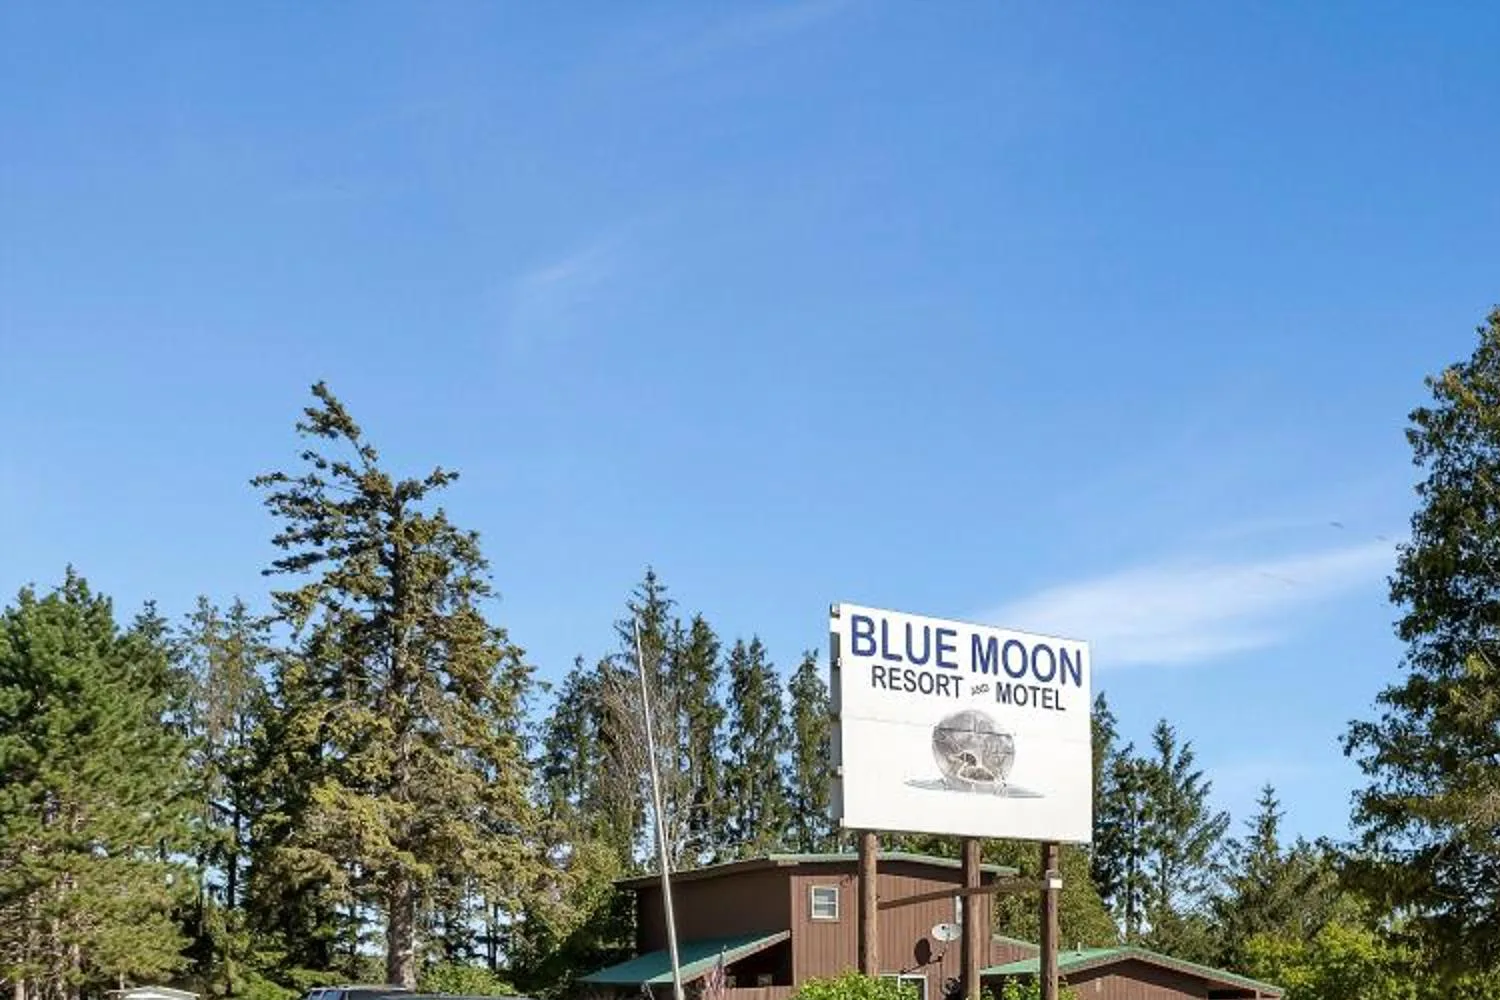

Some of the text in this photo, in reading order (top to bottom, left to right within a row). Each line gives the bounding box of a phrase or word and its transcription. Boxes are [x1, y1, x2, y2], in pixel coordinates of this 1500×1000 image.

[851, 613, 1083, 688] BLUE MOON
[871, 665, 965, 699] RESORT
[995, 681, 1066, 711] MOTEL
